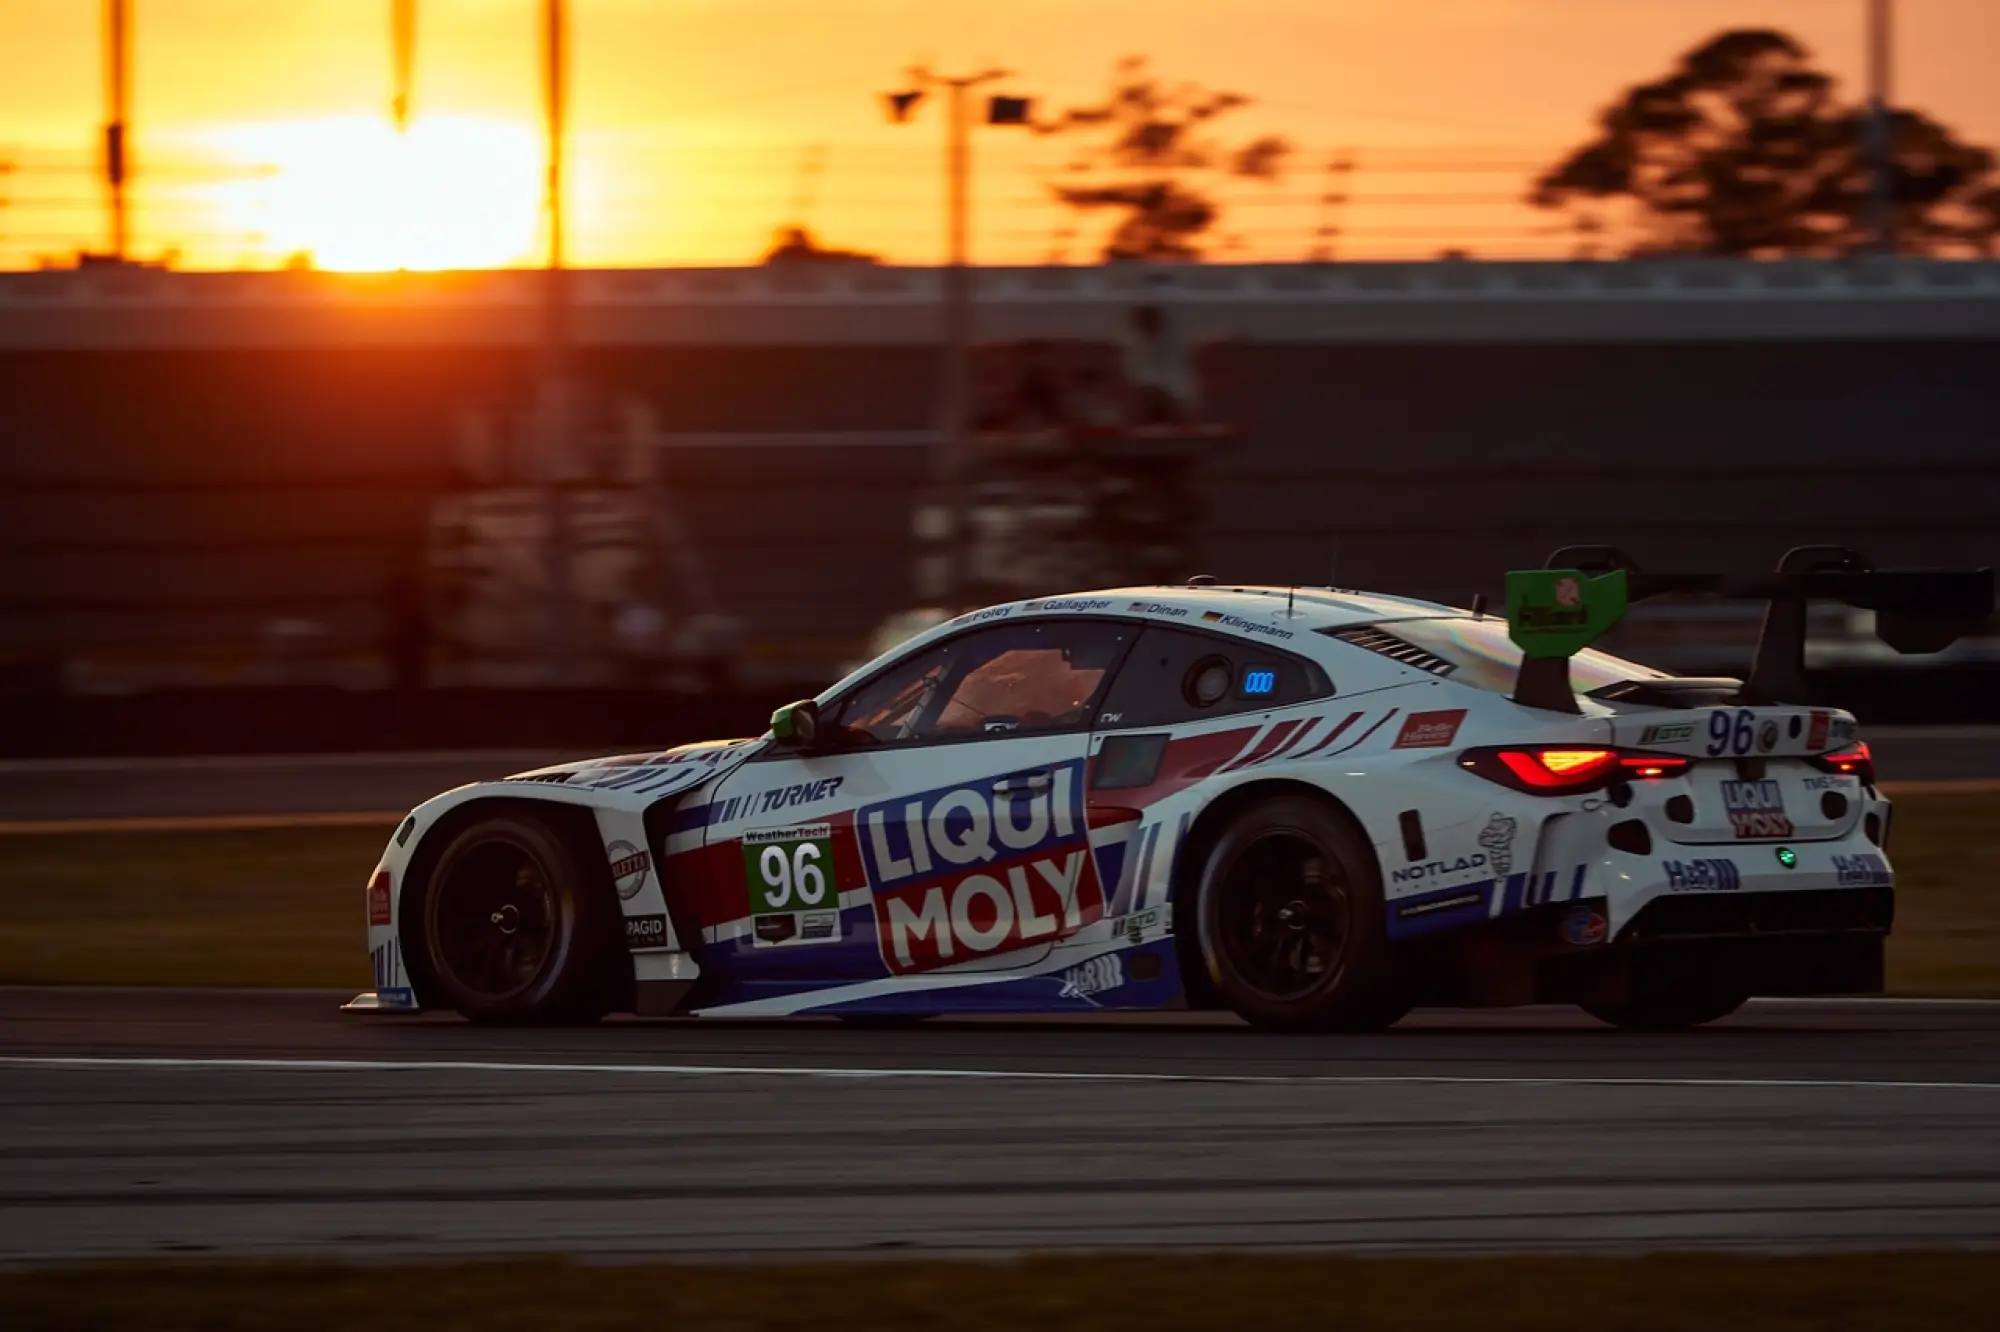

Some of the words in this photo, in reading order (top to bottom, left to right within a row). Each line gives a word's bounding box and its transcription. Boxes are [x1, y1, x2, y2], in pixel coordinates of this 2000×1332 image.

[972, 605, 1013, 621] Foley
[1044, 600, 1112, 611] Gallagher
[1148, 603, 1188, 617] Dinan
[1221, 614, 1294, 640] Klingmann
[1706, 710, 1755, 756] 96
[761, 776, 843, 813] TURNER
[1722, 782, 1783, 809] LIQUI
[746, 826, 828, 841] WeatherTech
[868, 766, 1075, 883] LIQUI
[1731, 812, 1790, 837] MOLY
[760, 842, 826, 908] 96
[1392, 853, 1486, 883] NOTLAD
[886, 849, 1087, 968] MOLY
[626, 919, 663, 936] PAGID
